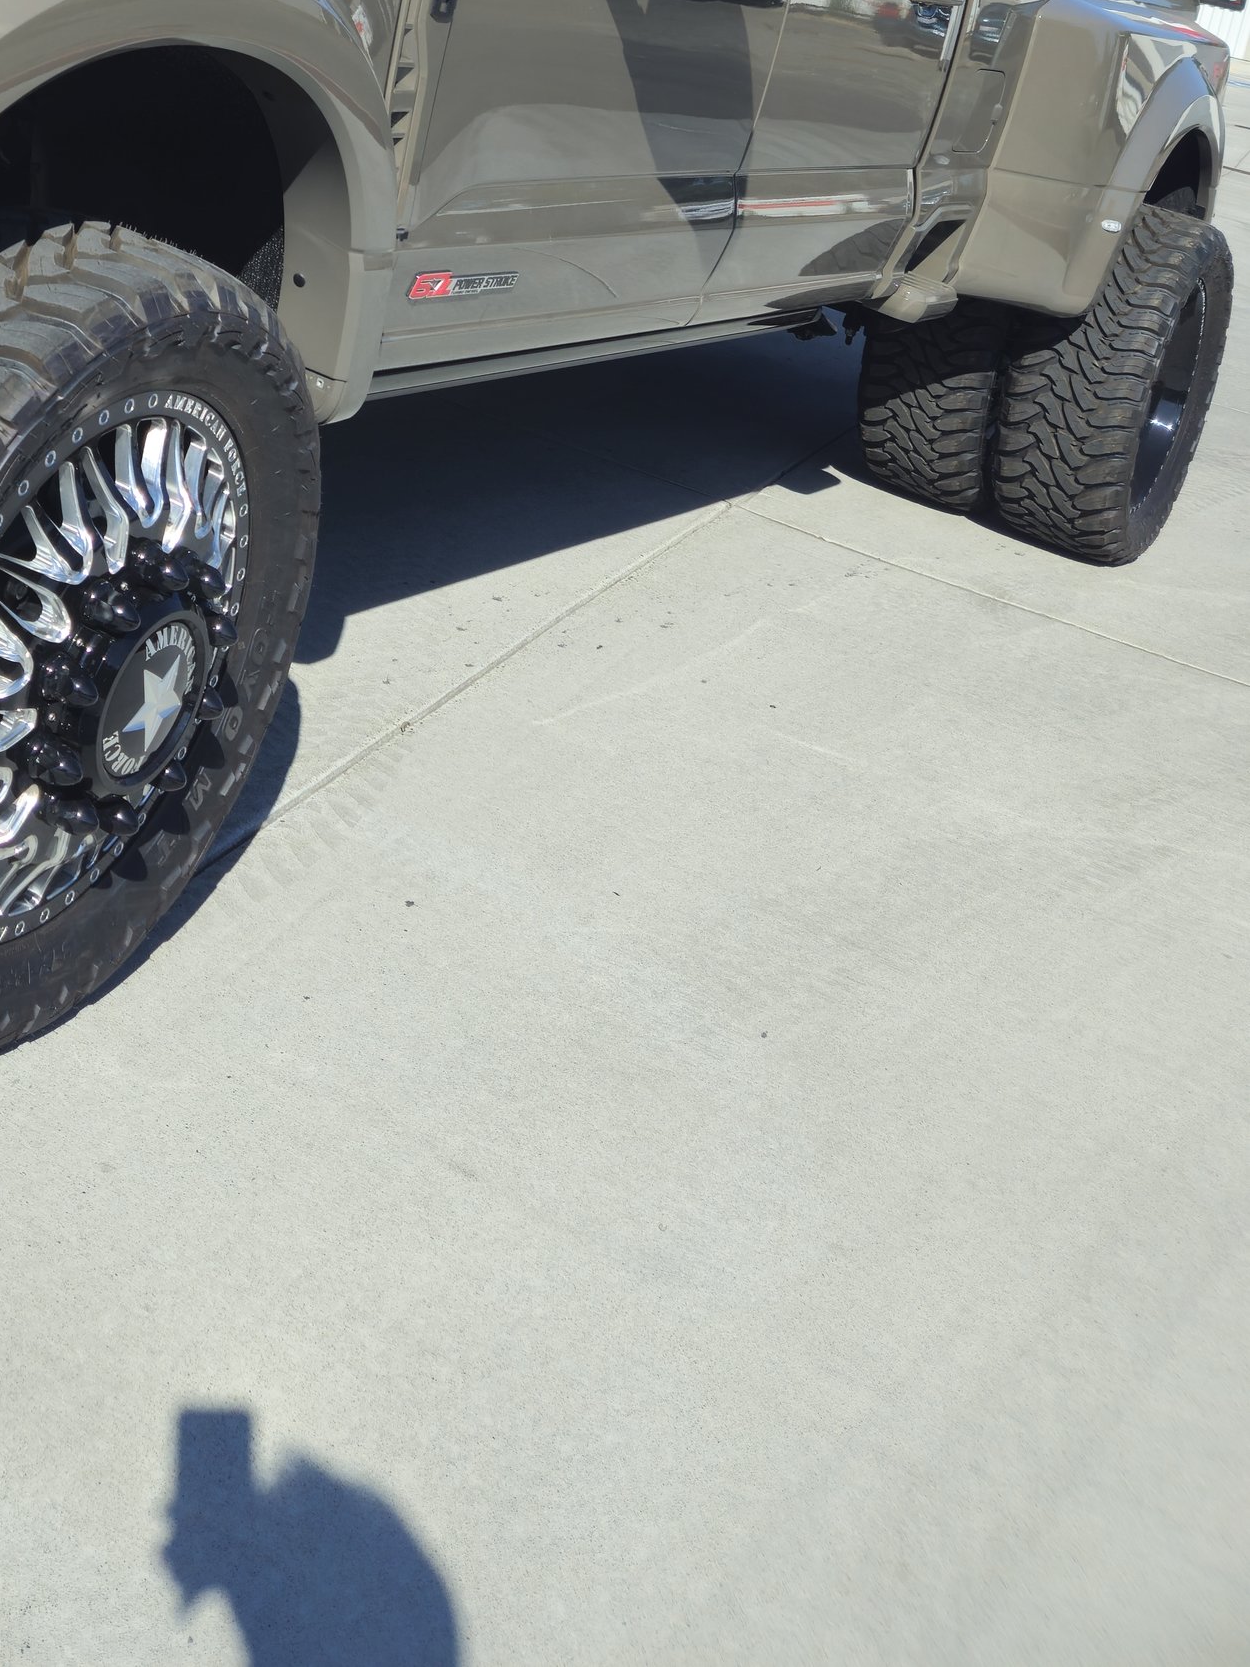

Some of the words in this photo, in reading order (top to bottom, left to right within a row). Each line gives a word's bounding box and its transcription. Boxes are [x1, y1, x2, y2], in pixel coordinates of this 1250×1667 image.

[410, 272, 453, 299] 6.7
[453, 277, 485, 291] POWER
[483, 275, 518, 288] STROKE
[164, 394, 227, 441] AMERICAN
[223, 438, 246, 498] FORCE
[145, 625, 196, 695] AMERICAN
[102, 731, 146, 775] FORCE
